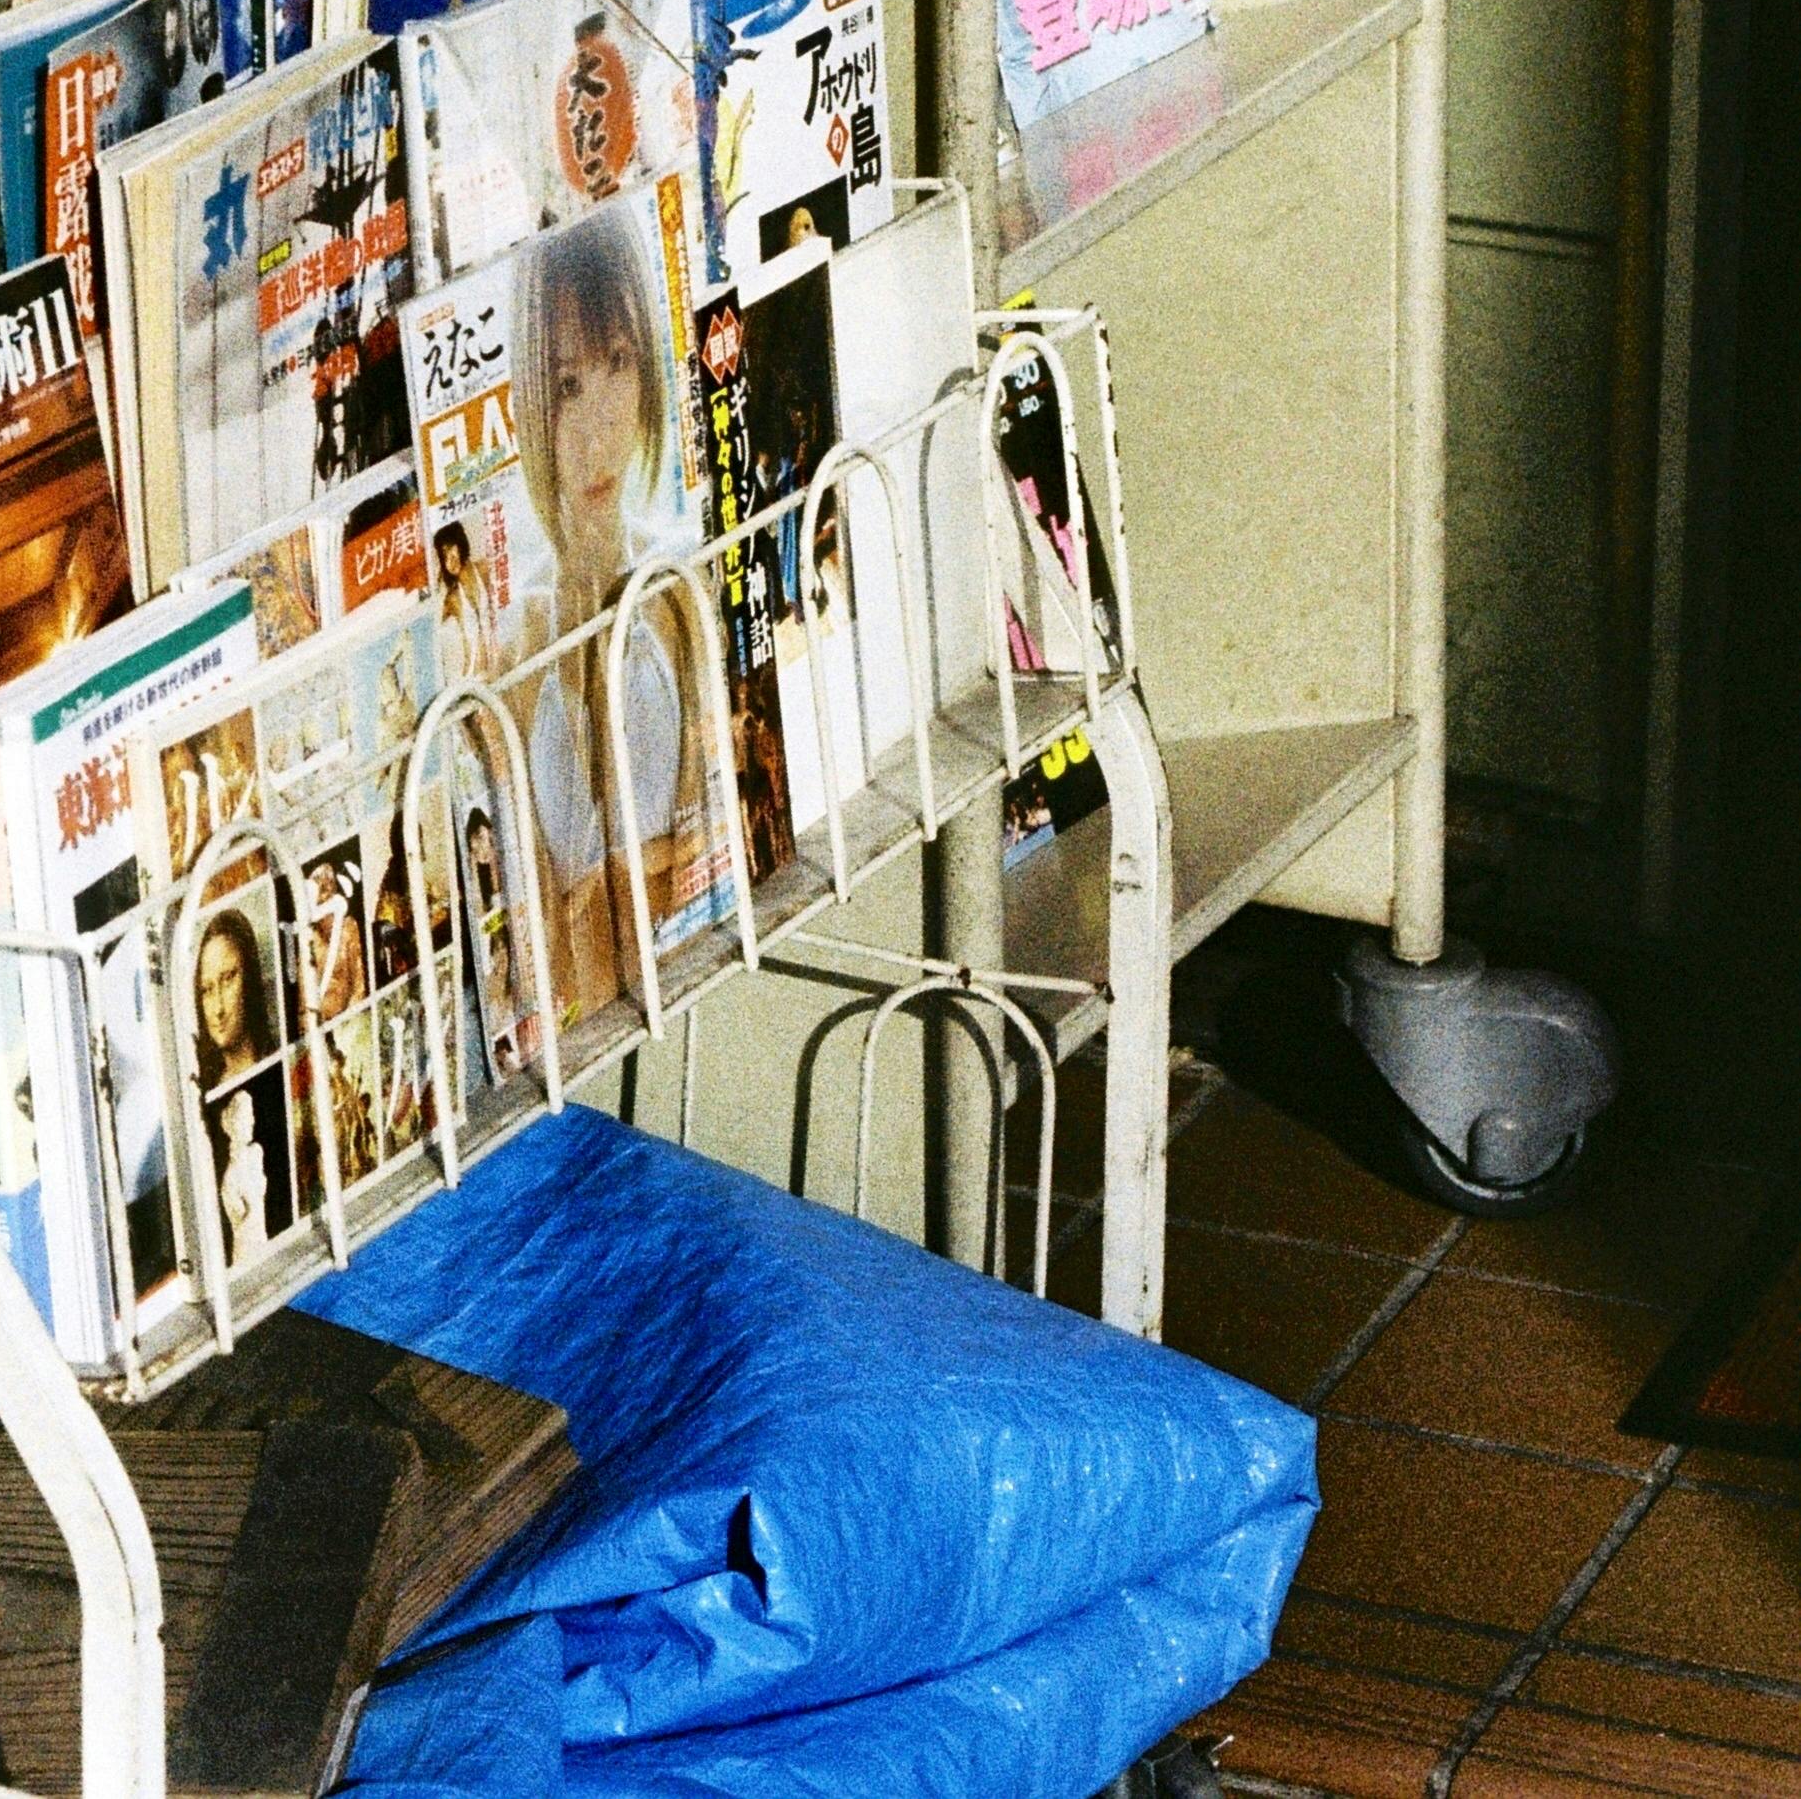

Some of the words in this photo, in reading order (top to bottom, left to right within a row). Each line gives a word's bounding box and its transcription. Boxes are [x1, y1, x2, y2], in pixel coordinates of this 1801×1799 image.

[795, 25, 878, 126] アホウドリ
[849, 102, 882, 196] 島
[423, 305, 505, 401] えなこ
